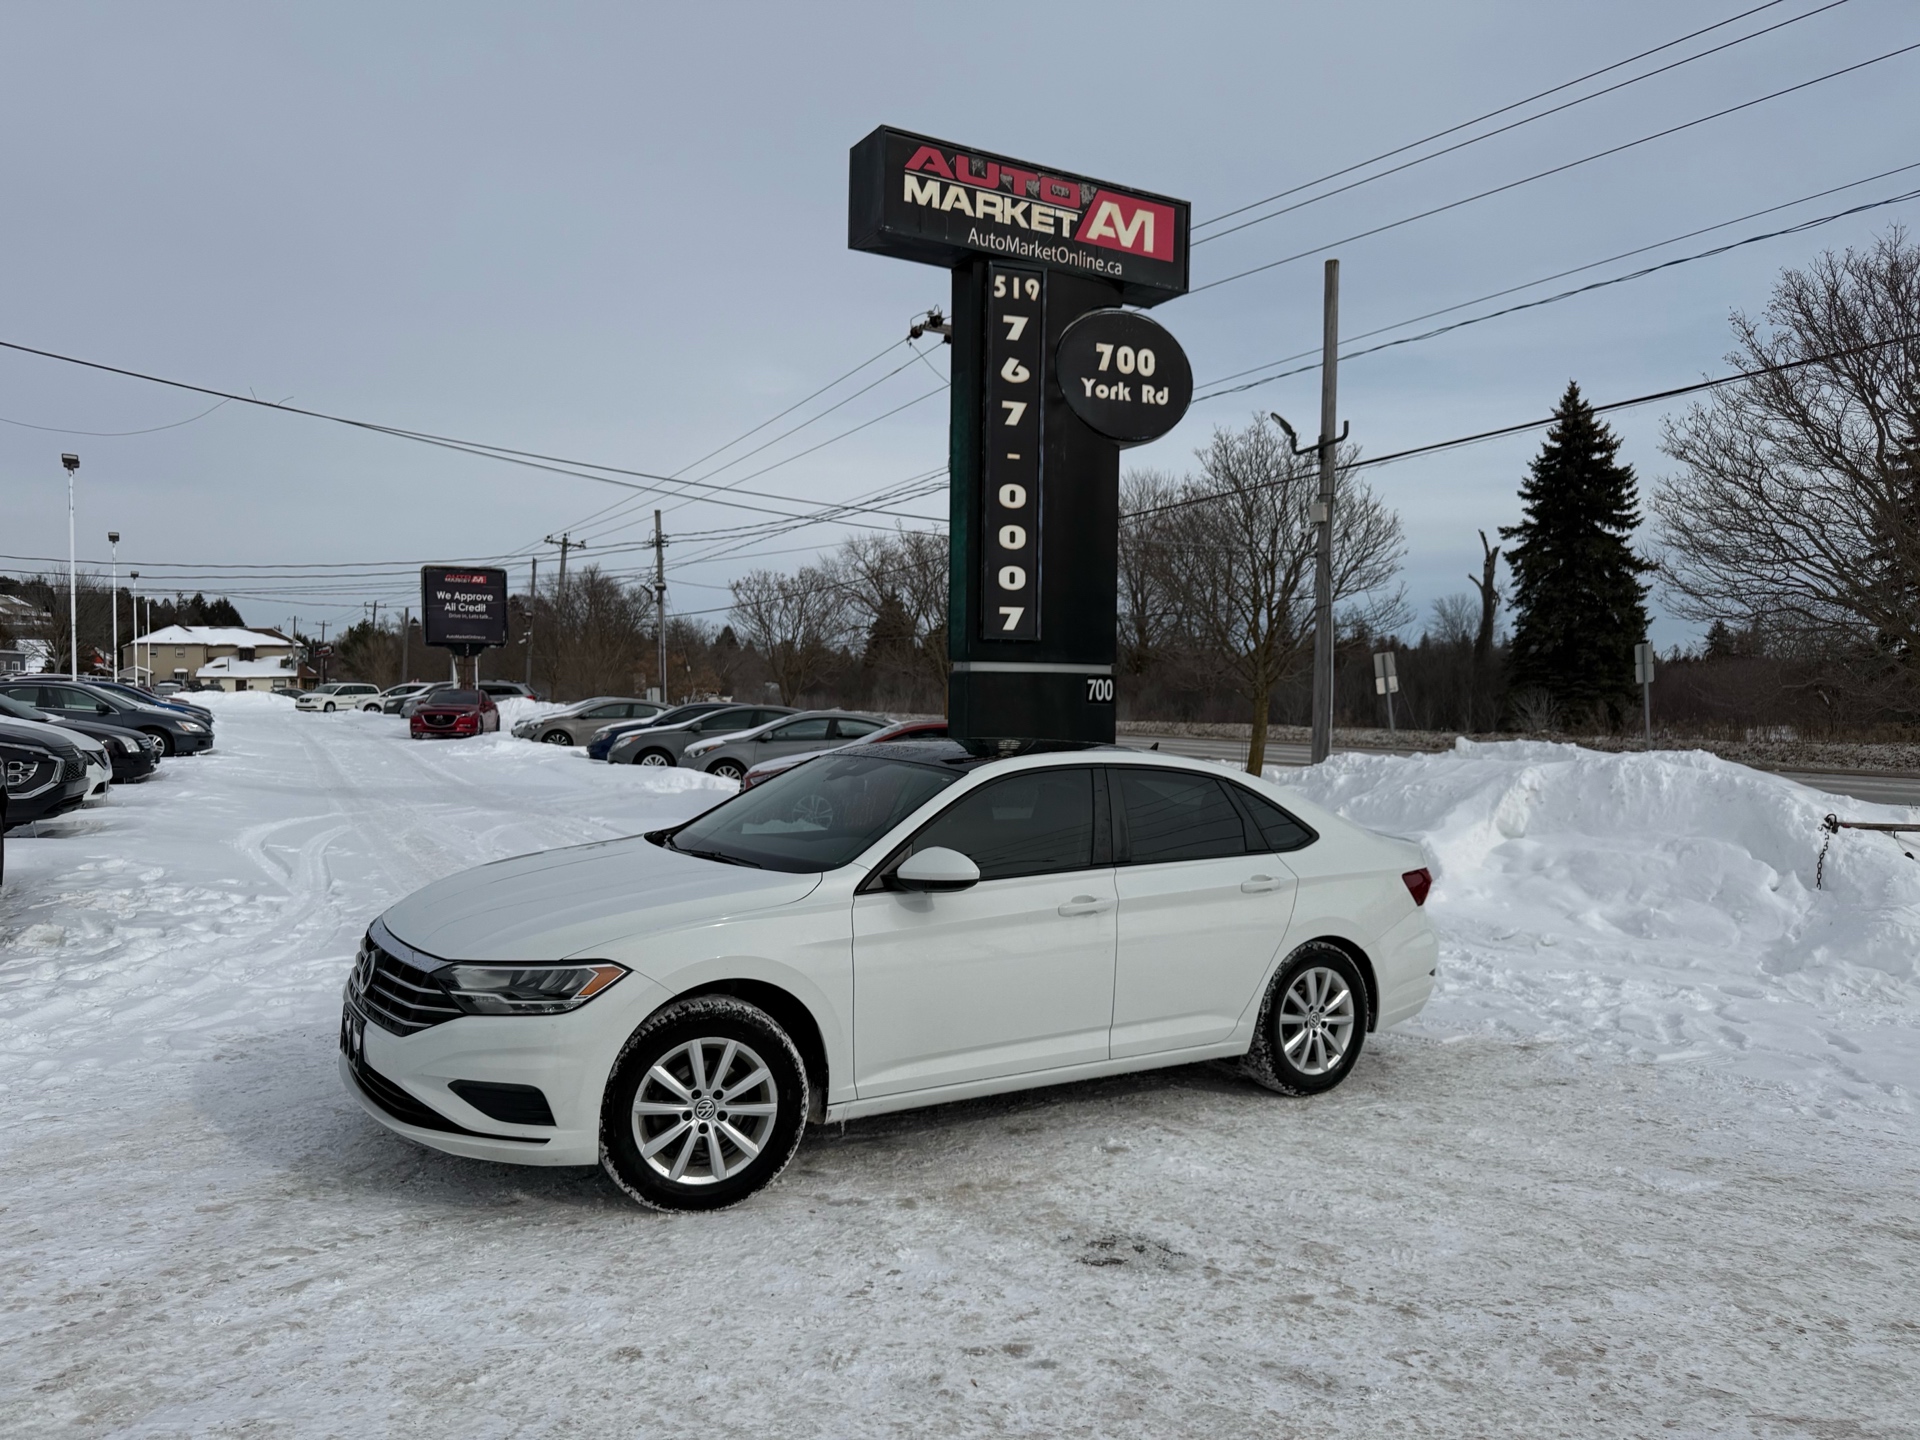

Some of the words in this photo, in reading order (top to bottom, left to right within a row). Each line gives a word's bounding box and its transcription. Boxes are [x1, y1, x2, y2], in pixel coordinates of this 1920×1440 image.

[904, 145, 1081, 209] AUTO
[904, 173, 1078, 238] MARKET
[968, 226, 1123, 276] AutoMarketOnline.ca
[993, 275, 1040, 301] 519
[1095, 342, 1156, 377] 700
[1081, 377, 1131, 402] York
[1141, 384, 1169, 406] Rd
[436, 591, 451, 600] We
[454, 592, 493, 602] Approve
[444, 602, 456, 611] All
[458, 603, 486, 612] Credit
[1087, 679, 1113, 701] 700
